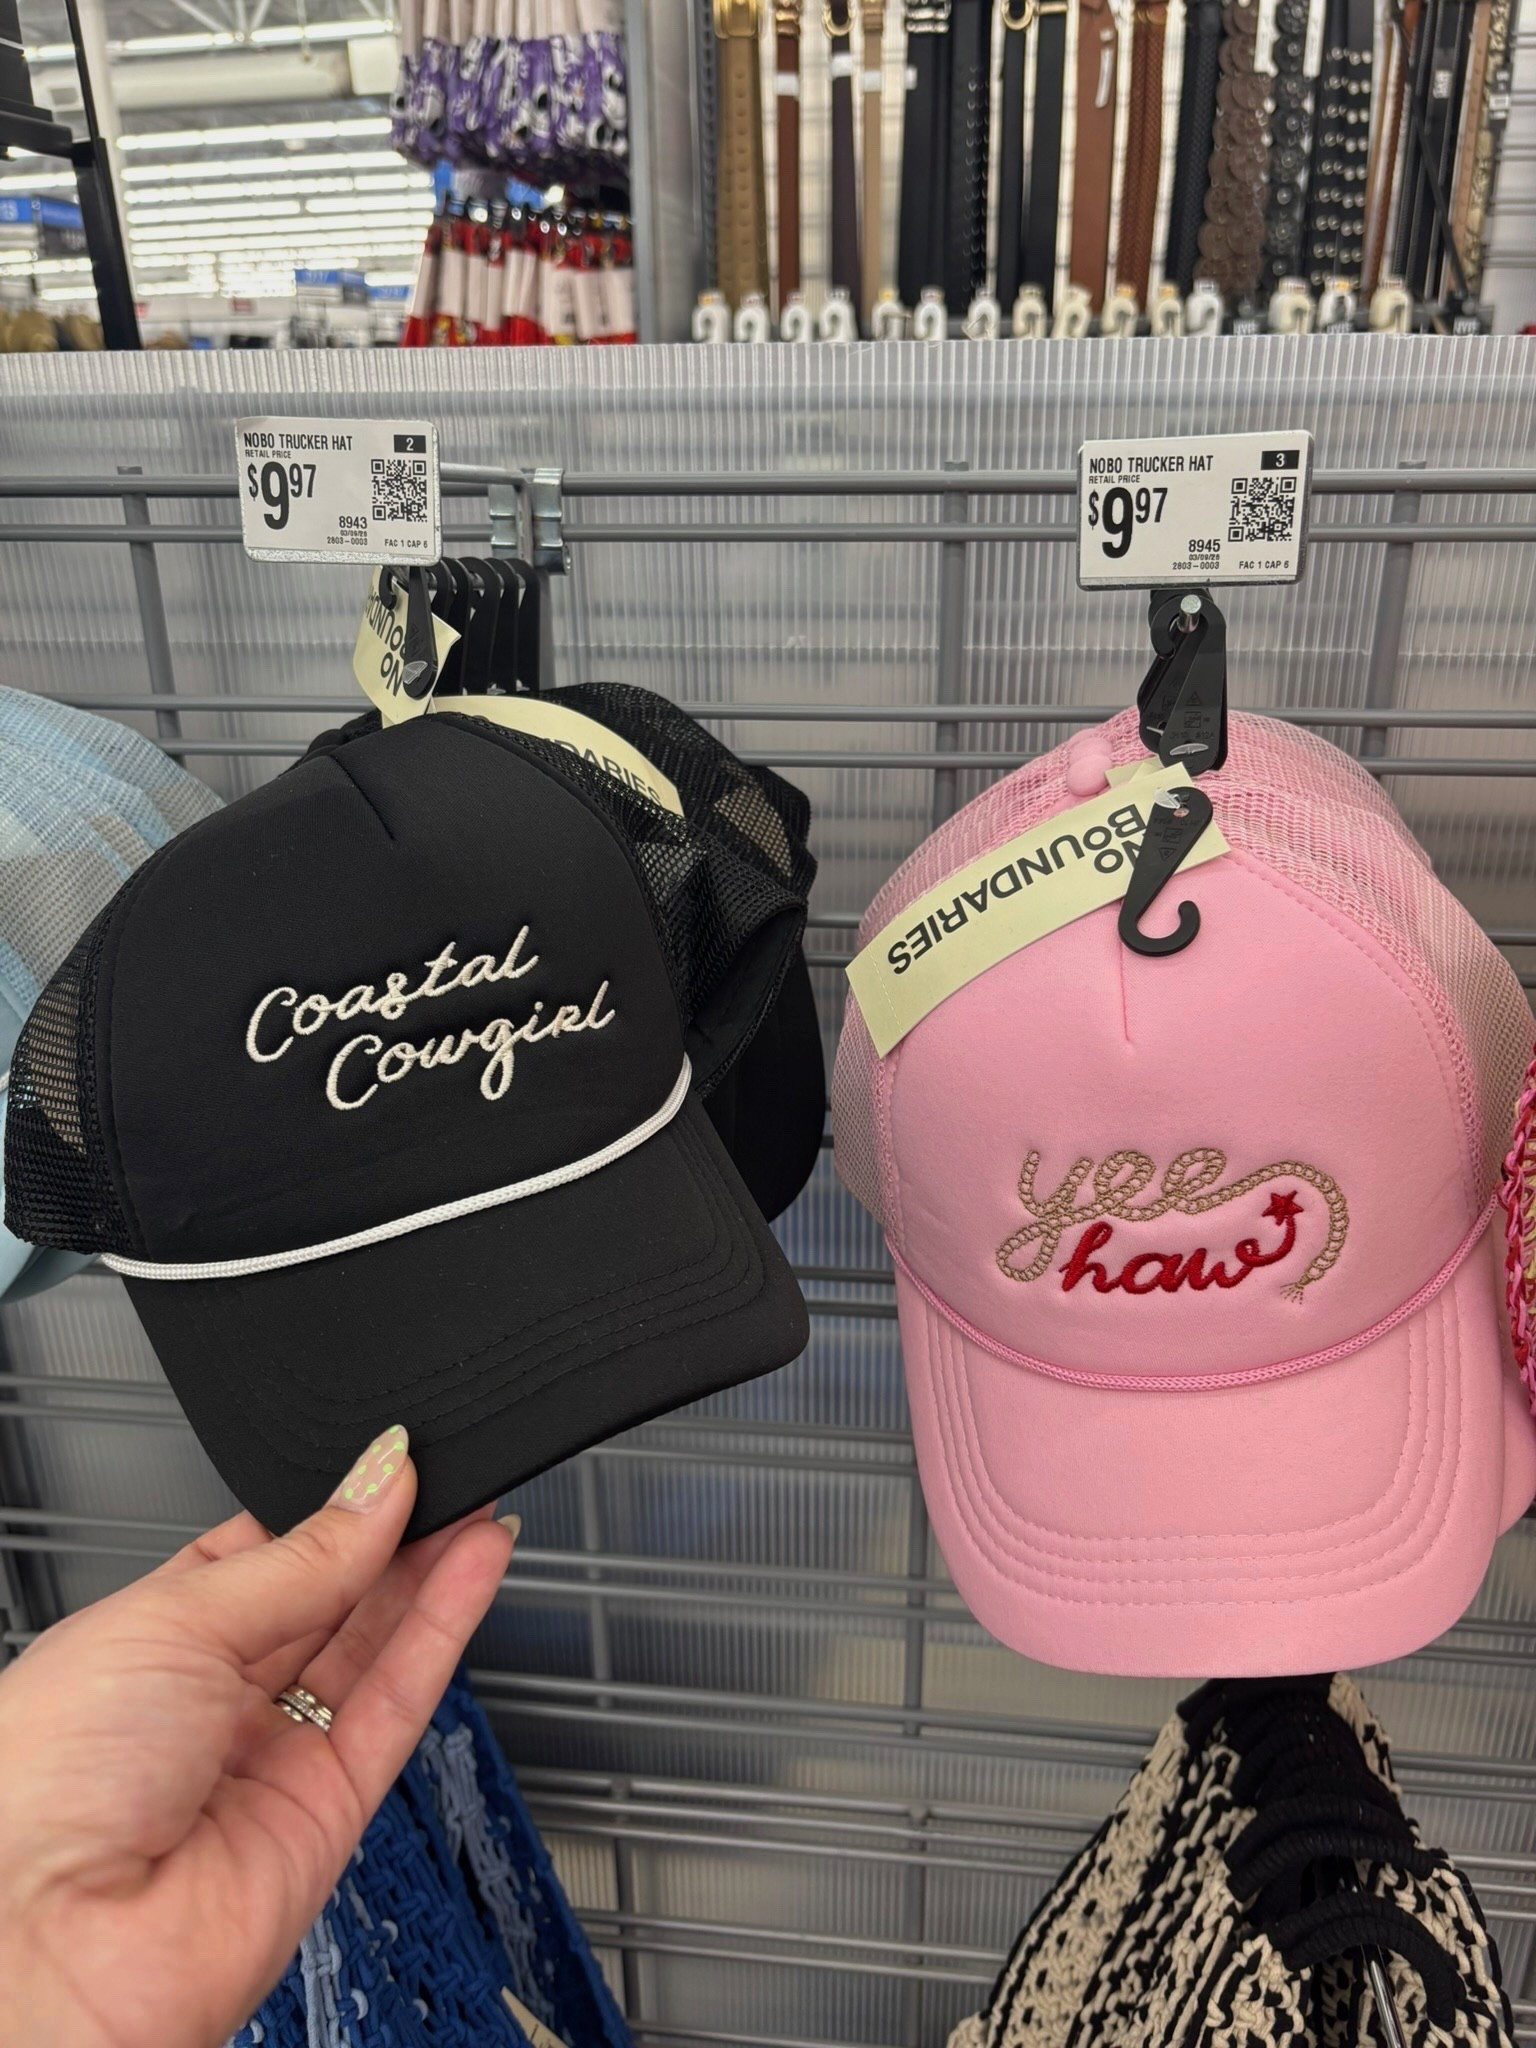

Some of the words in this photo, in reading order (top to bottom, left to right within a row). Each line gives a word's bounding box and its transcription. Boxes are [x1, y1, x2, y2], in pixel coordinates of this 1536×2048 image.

[243, 433, 275, 449] NOBO
[279, 433, 329, 450] TRUCKER
[332, 435, 353, 451] HAT
[405, 437, 414, 451] 2
[245, 449, 270, 458] RETAIL
[272, 450, 292, 459] PRICE
[1275, 453, 1285, 467] 3
[1089, 457, 1123, 474] NOBO
[1128, 455, 1184, 473] TRUCKER
[1189, 455, 1214, 472] HAT
[1088, 475, 1116, 484] RETAIL
[1118, 474, 1141, 484] PRICE
[339, 516, 368, 529] 8943
[384, 539, 398, 547] FAC
[407, 539, 422, 548] CAP
[1188, 539, 1221, 553] 8945
[1238, 560, 1255, 569] FAC
[1264, 560, 1282, 569] CAP
[887, 803, 1147, 975] BOUNDARIES
[246, 924, 540, 1063] Coastal
[325, 980, 616, 1110] Cowgirl
[1059, 1220, 1264, 1294] haw
